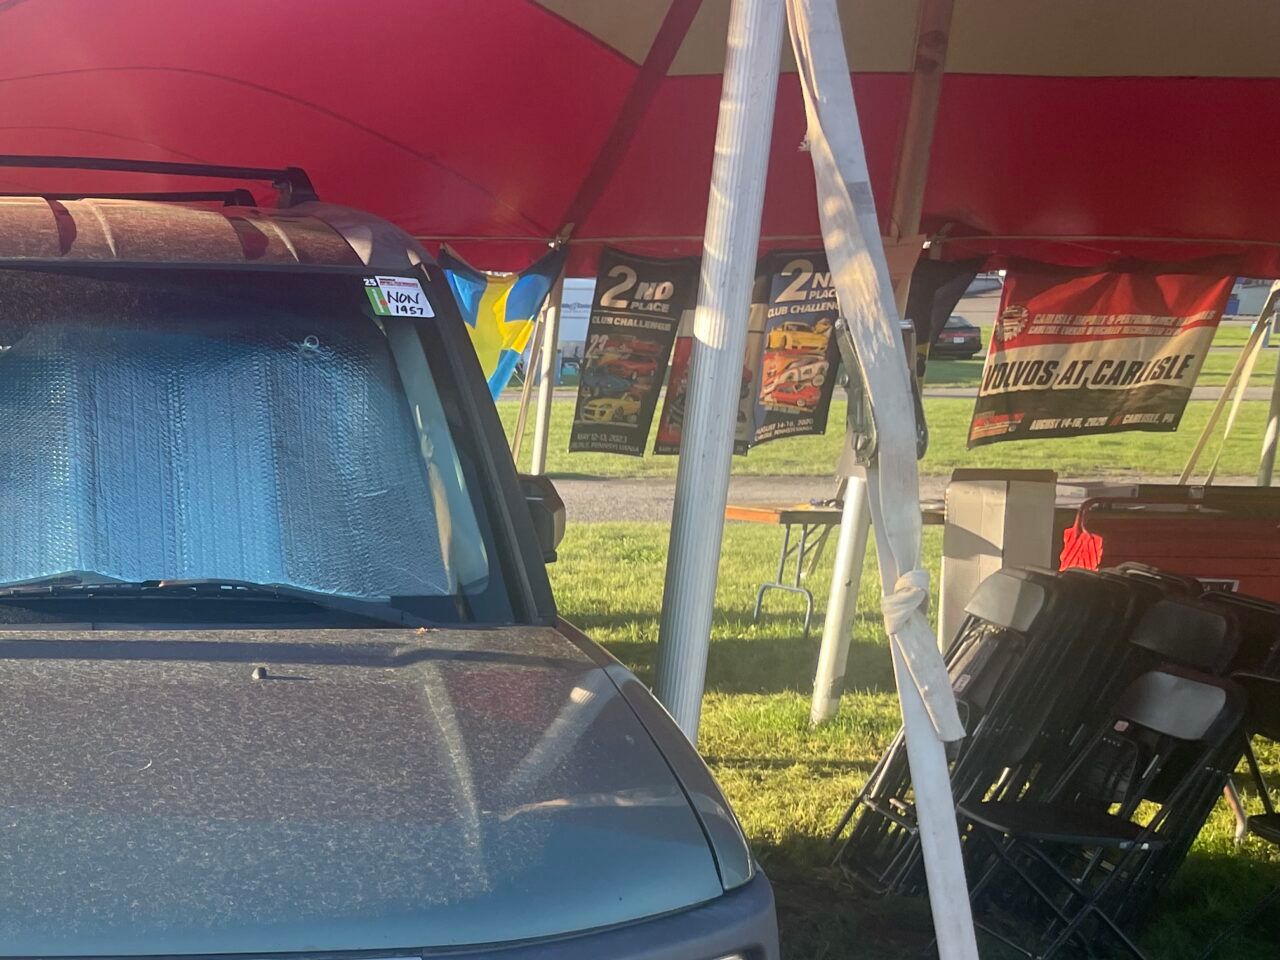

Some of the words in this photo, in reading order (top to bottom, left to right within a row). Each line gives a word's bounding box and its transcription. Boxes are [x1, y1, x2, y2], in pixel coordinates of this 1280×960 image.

[387, 290, 420, 304] NON
[808, 288, 838, 300] PLAC
[395, 304, 424, 315] 1957
[629, 300, 671, 313] PLACE
[767, 305, 788, 318] CLUB
[613, 316, 672, 332] CHALLENGE
[983, 360, 1060, 392] VOLVOS
[1058, 359, 1093, 386] AT
[1092, 354, 1195, 386] CARLISLE
[1029, 418, 1061, 434] AUGUST
